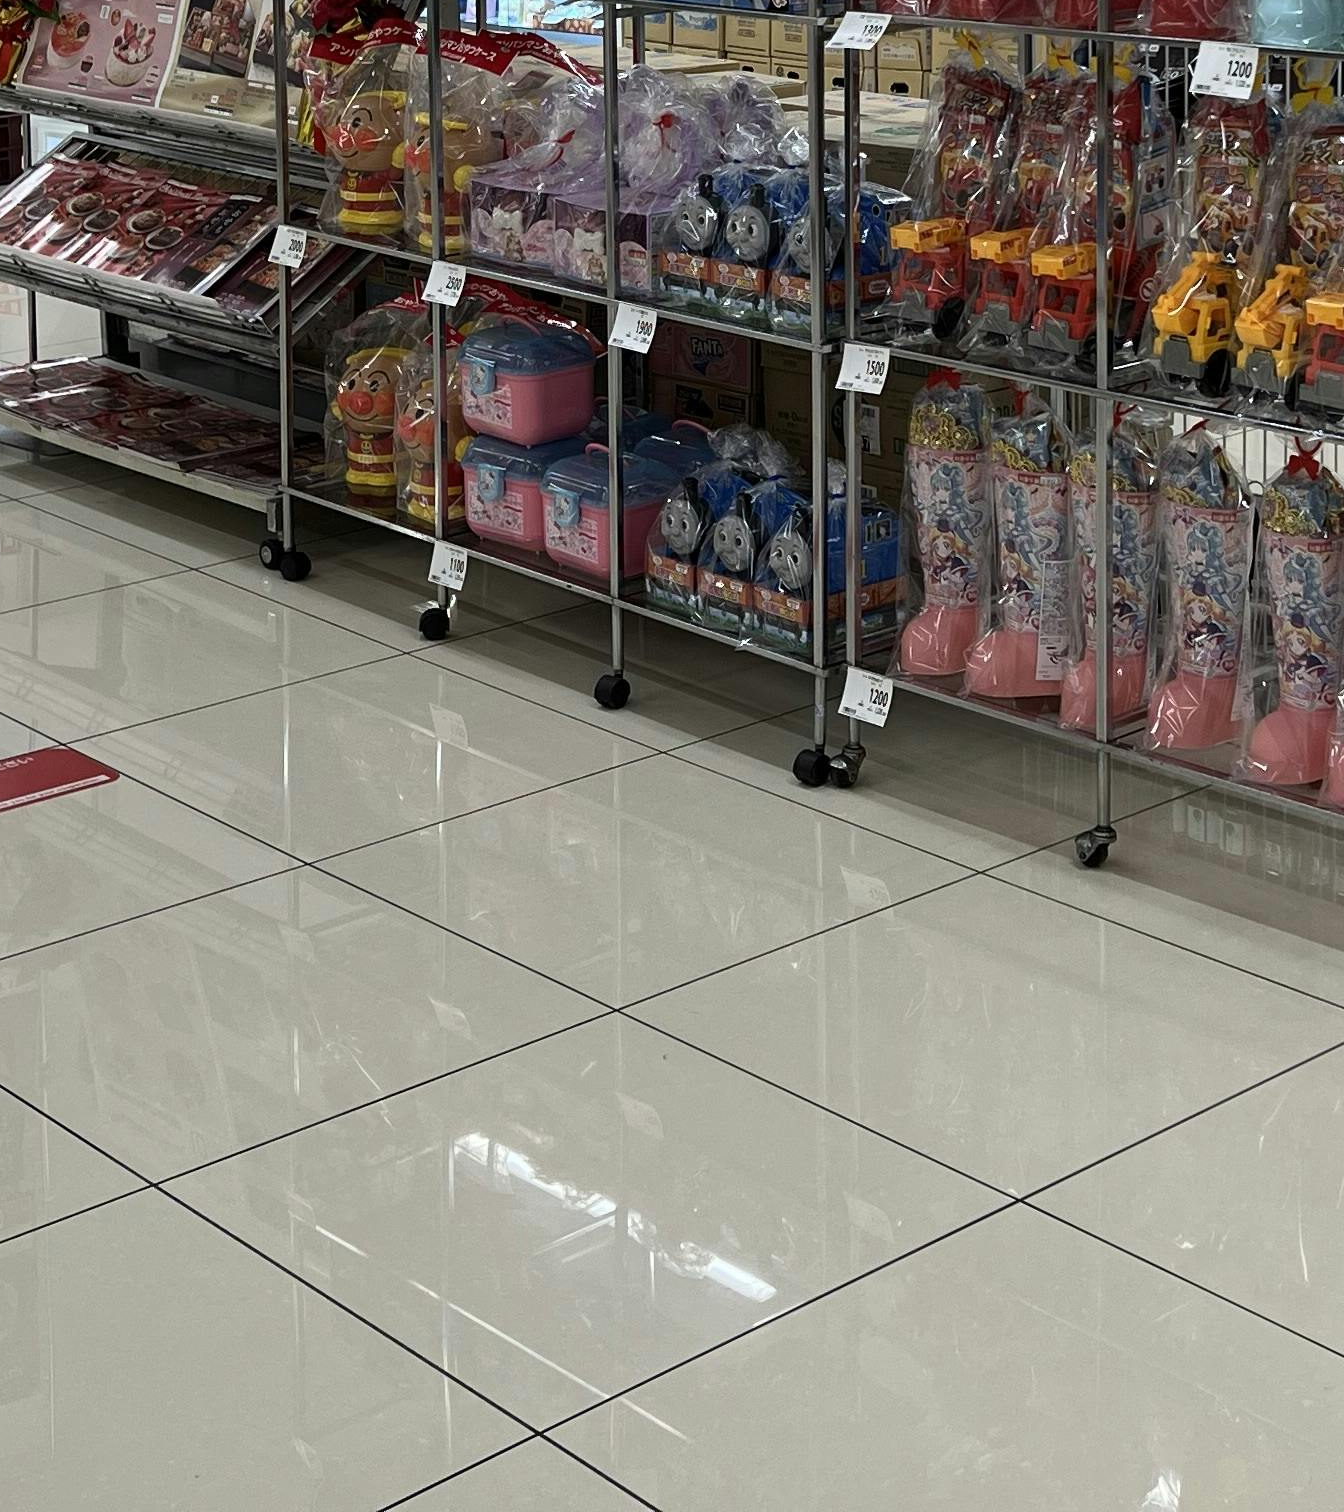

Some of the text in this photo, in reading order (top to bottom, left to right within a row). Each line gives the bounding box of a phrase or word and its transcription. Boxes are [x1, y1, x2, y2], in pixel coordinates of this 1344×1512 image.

[1227, 60, 1253, 79] 1200
[289, 239, 303, 252] 2000
[446, 277, 463, 291] 2500
[636, 319, 653, 337] 1900
[692, 338, 723, 356] FANTA
[866, 360, 886, 376] 1500
[450, 557, 465, 574] 1100
[869, 687, 889, 707] 1200
